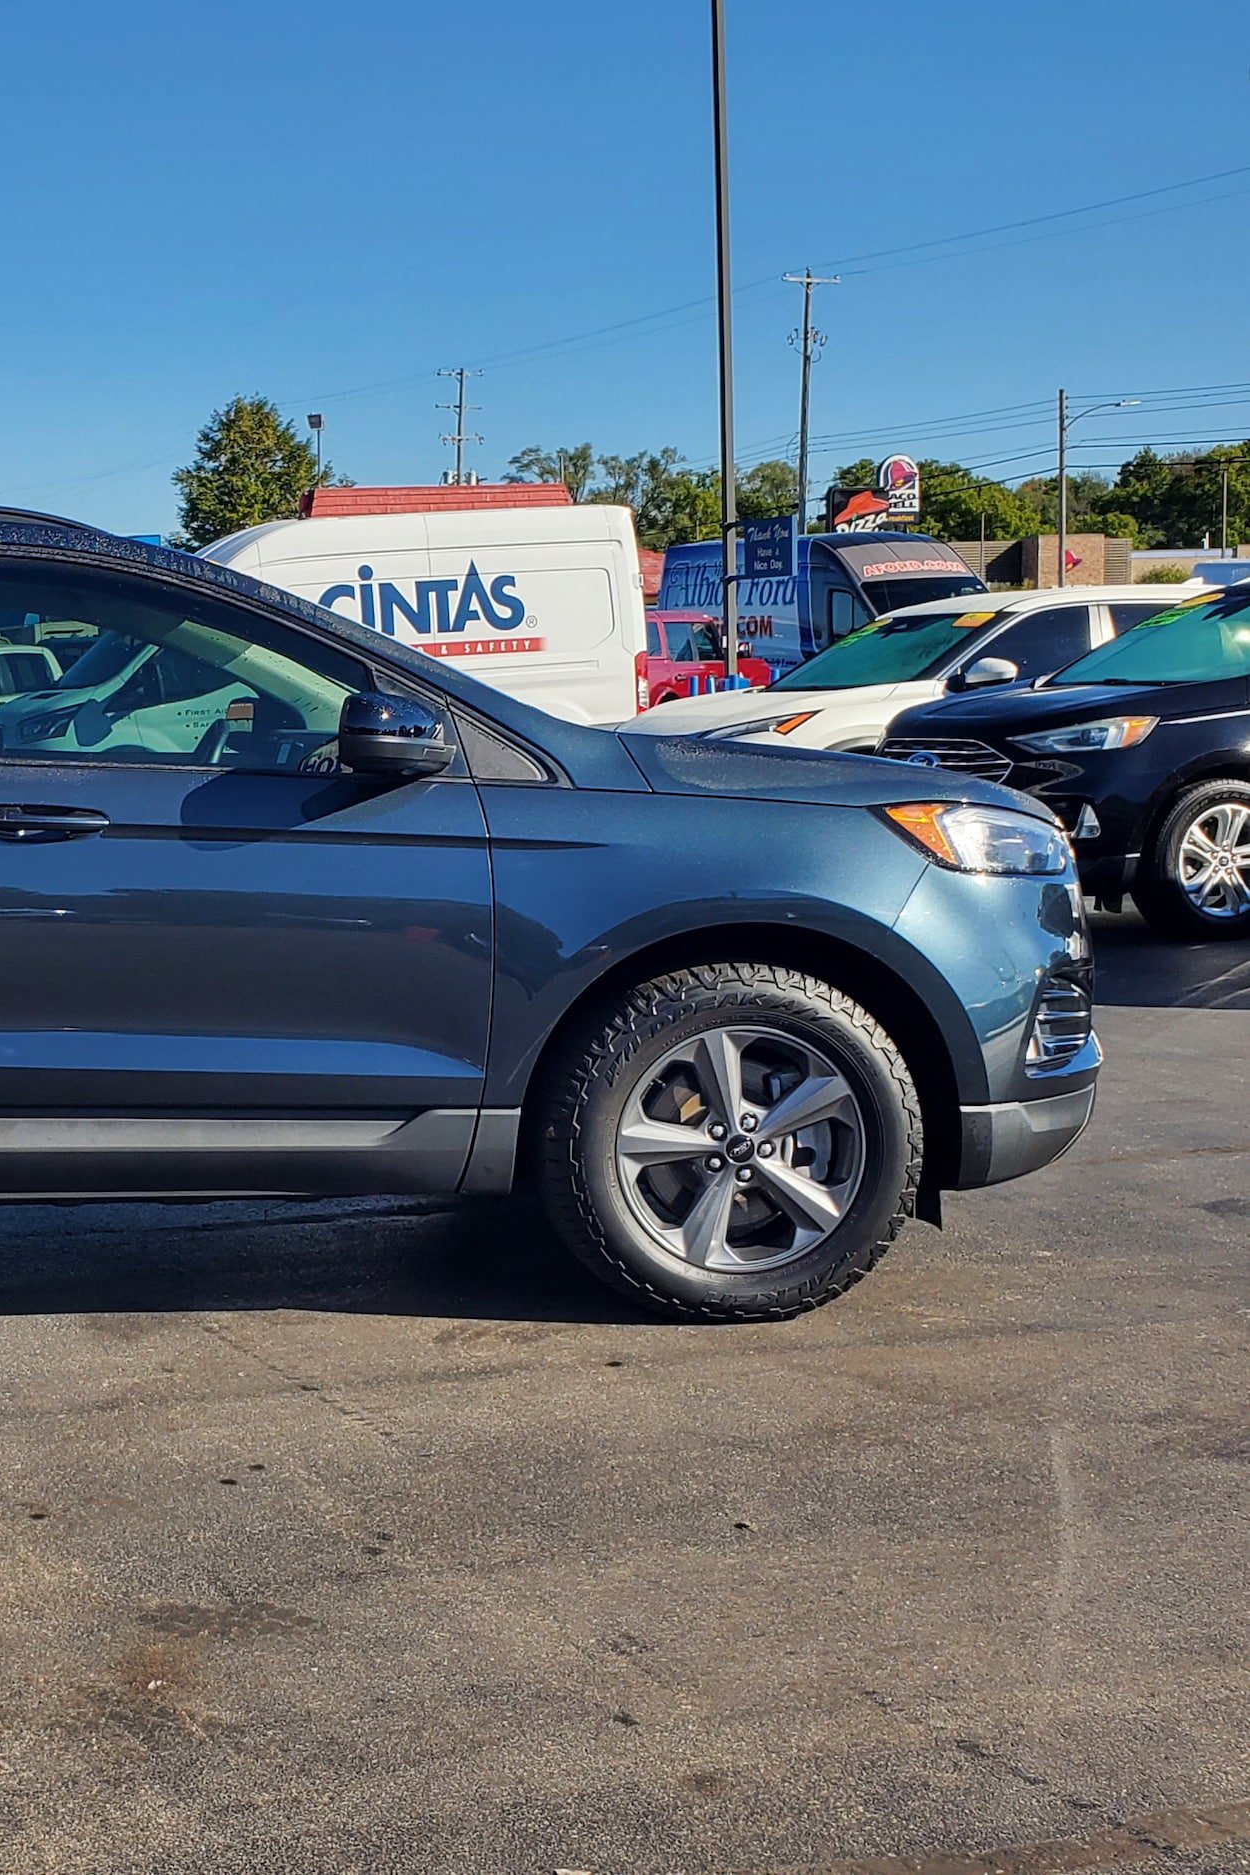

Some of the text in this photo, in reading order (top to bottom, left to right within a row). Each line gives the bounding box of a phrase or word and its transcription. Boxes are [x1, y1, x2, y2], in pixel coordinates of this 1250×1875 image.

[889, 491, 917, 501] ACO
[747, 523, 790, 543] Thank You
[757, 547, 773, 558] Have
[753, 559, 769, 571] Nice
[863, 560, 966, 577] AFORD.COM
[669, 560, 740, 608] Albio
[441, 640, 530, 655] & SAFETY
